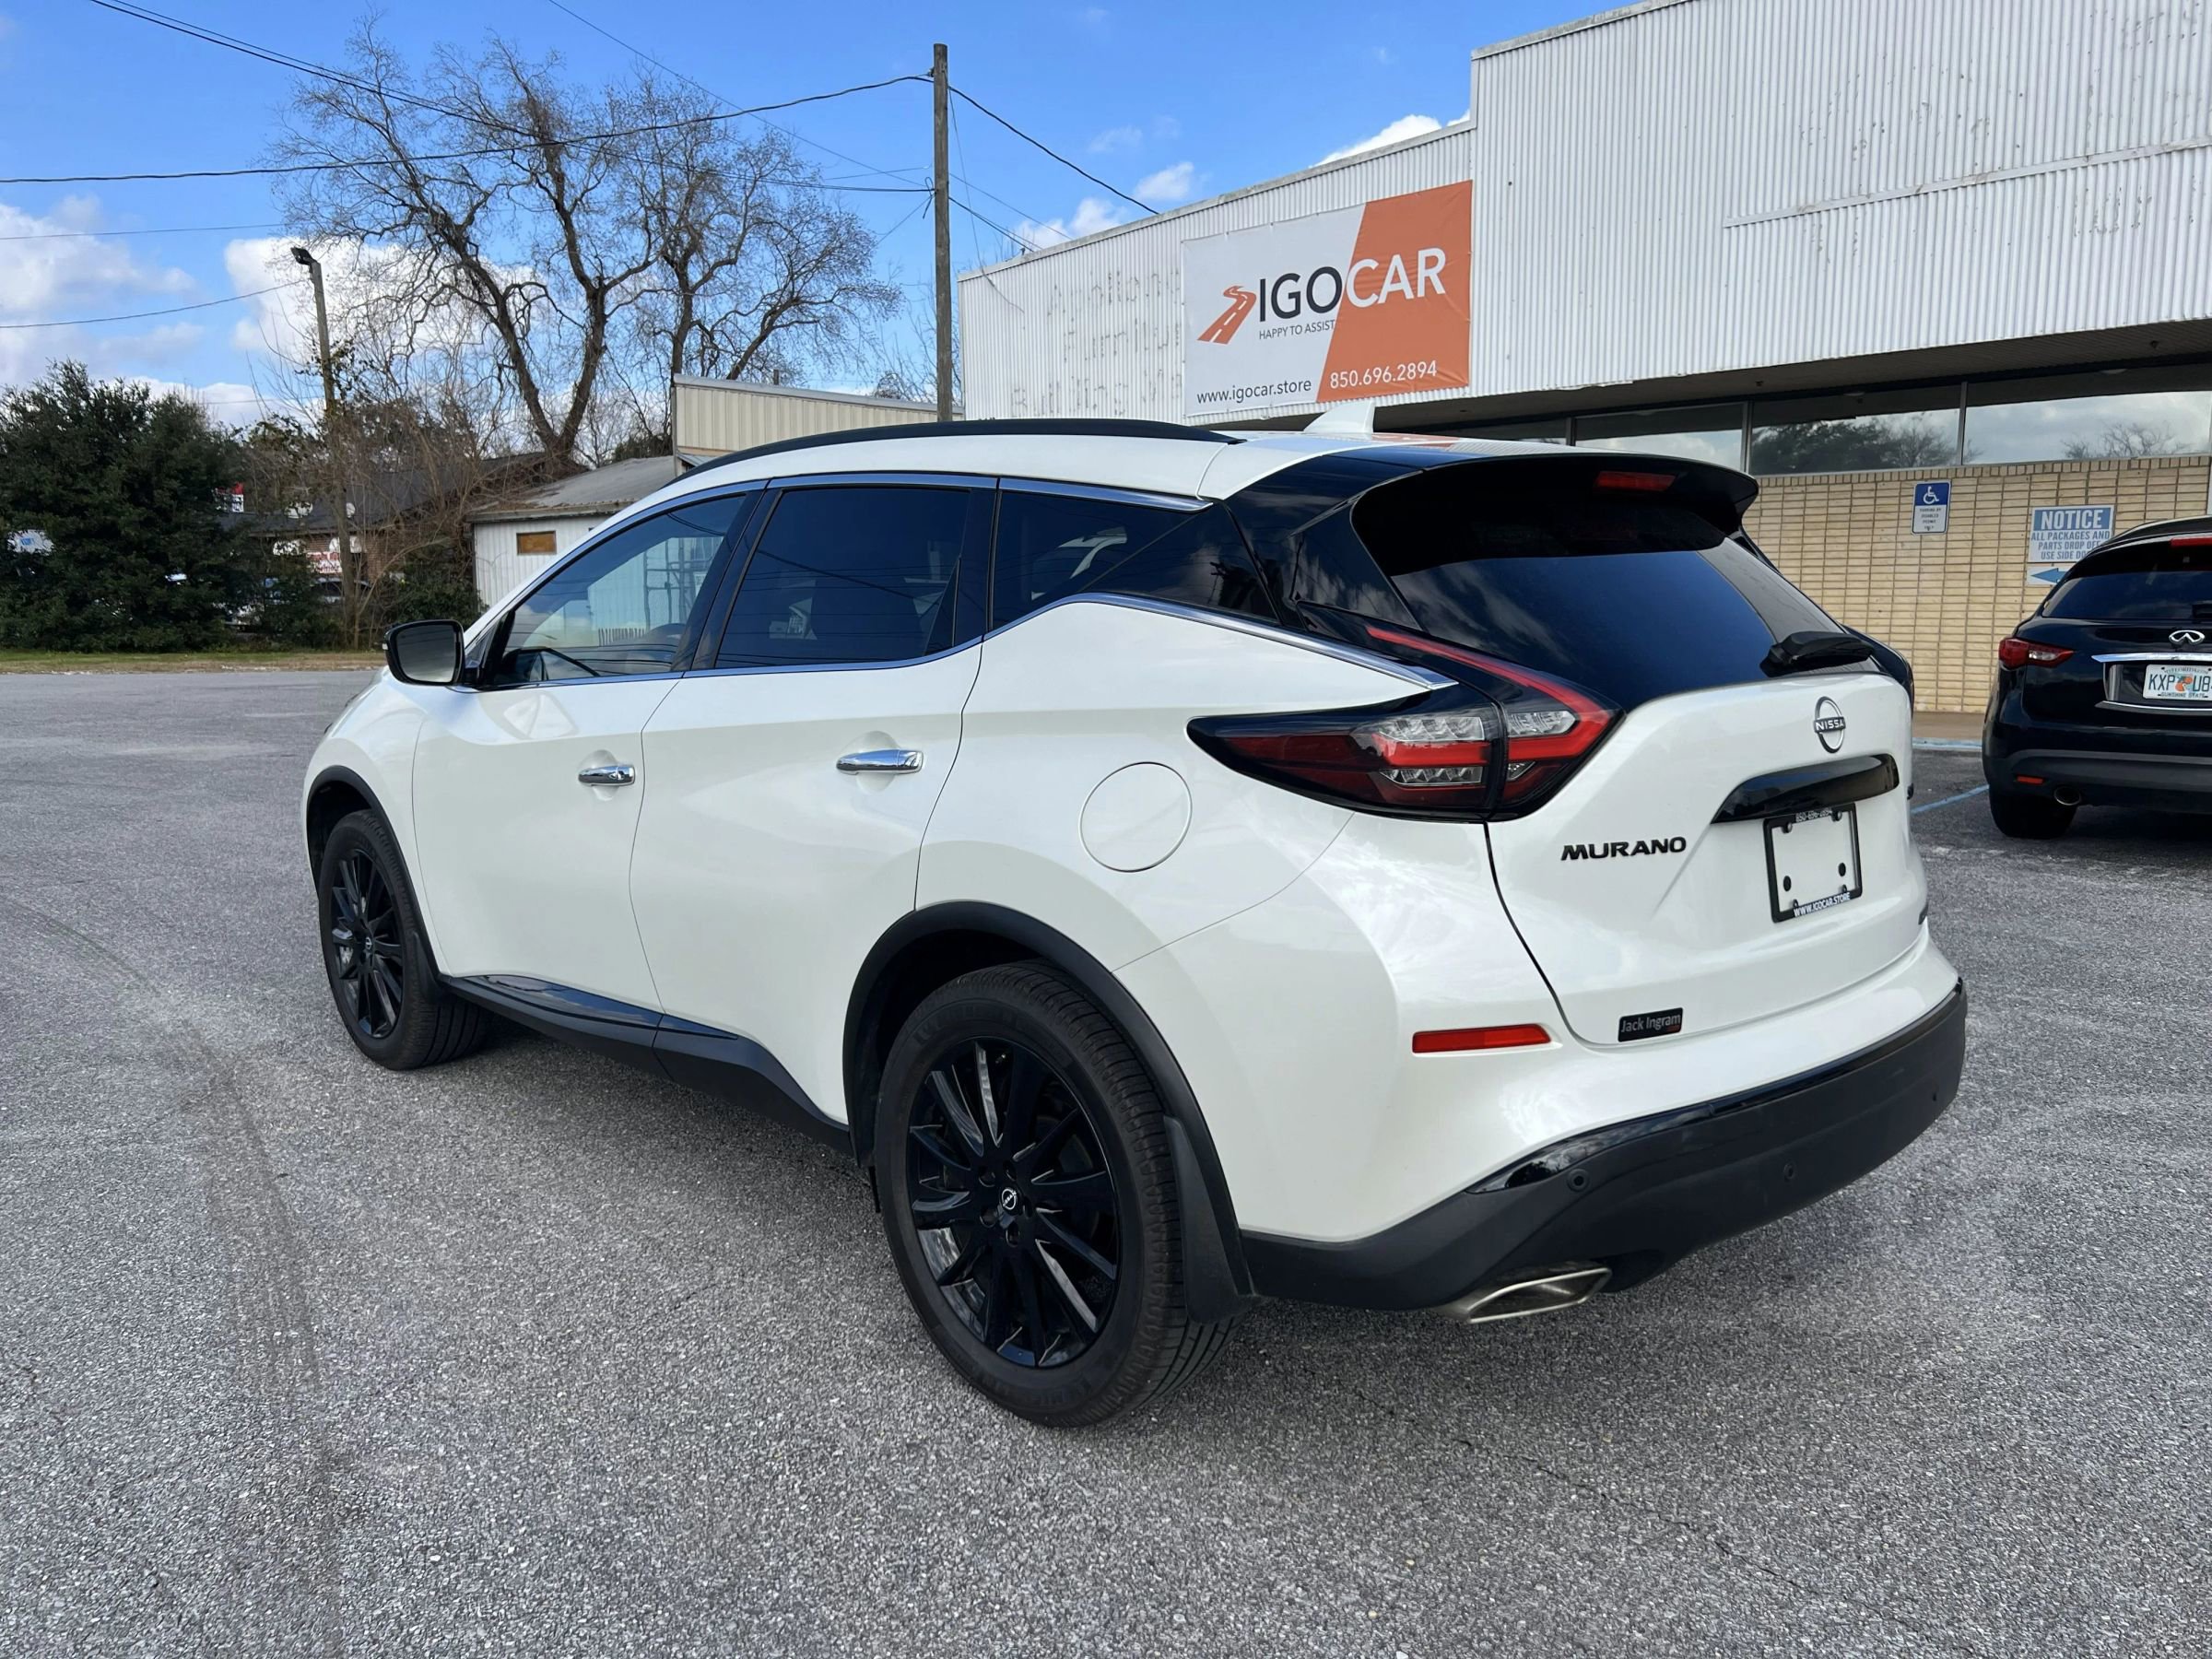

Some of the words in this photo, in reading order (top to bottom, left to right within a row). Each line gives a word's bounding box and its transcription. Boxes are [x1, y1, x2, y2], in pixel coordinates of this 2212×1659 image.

[1259, 247, 1446, 322] IGOCAR
[1259, 327, 1288, 340] HAPPY
[1289, 324, 1303, 335] TO
[1305, 319, 1335, 333] ASSIST
[1330, 359, 1438, 389] 850.696.2894
[1196, 378, 1312, 404] www.igocar.store
[2041, 509, 2103, 530] NOTICE
[2031, 532, 2045, 541] ALL
[2047, 531, 2090, 540] PACKAGES
[2092, 530, 2111, 540] AND
[2038, 541, 2064, 550] PARTS
[2065, 541, 2086, 550] DROP
[2041, 551, 2055, 560] USE
[2056, 550, 2074, 559] SIDE
[2076, 550, 2088, 559] DO
[2148, 674, 2175, 690] KXP
[2193, 676, 2212, 692] U8
[1815, 719, 1844, 731] NISSA
[1561, 835, 1688, 861] MURANO
[1620, 1017, 1644, 1033] Jack
[1645, 1014, 1681, 1031] Ingram
